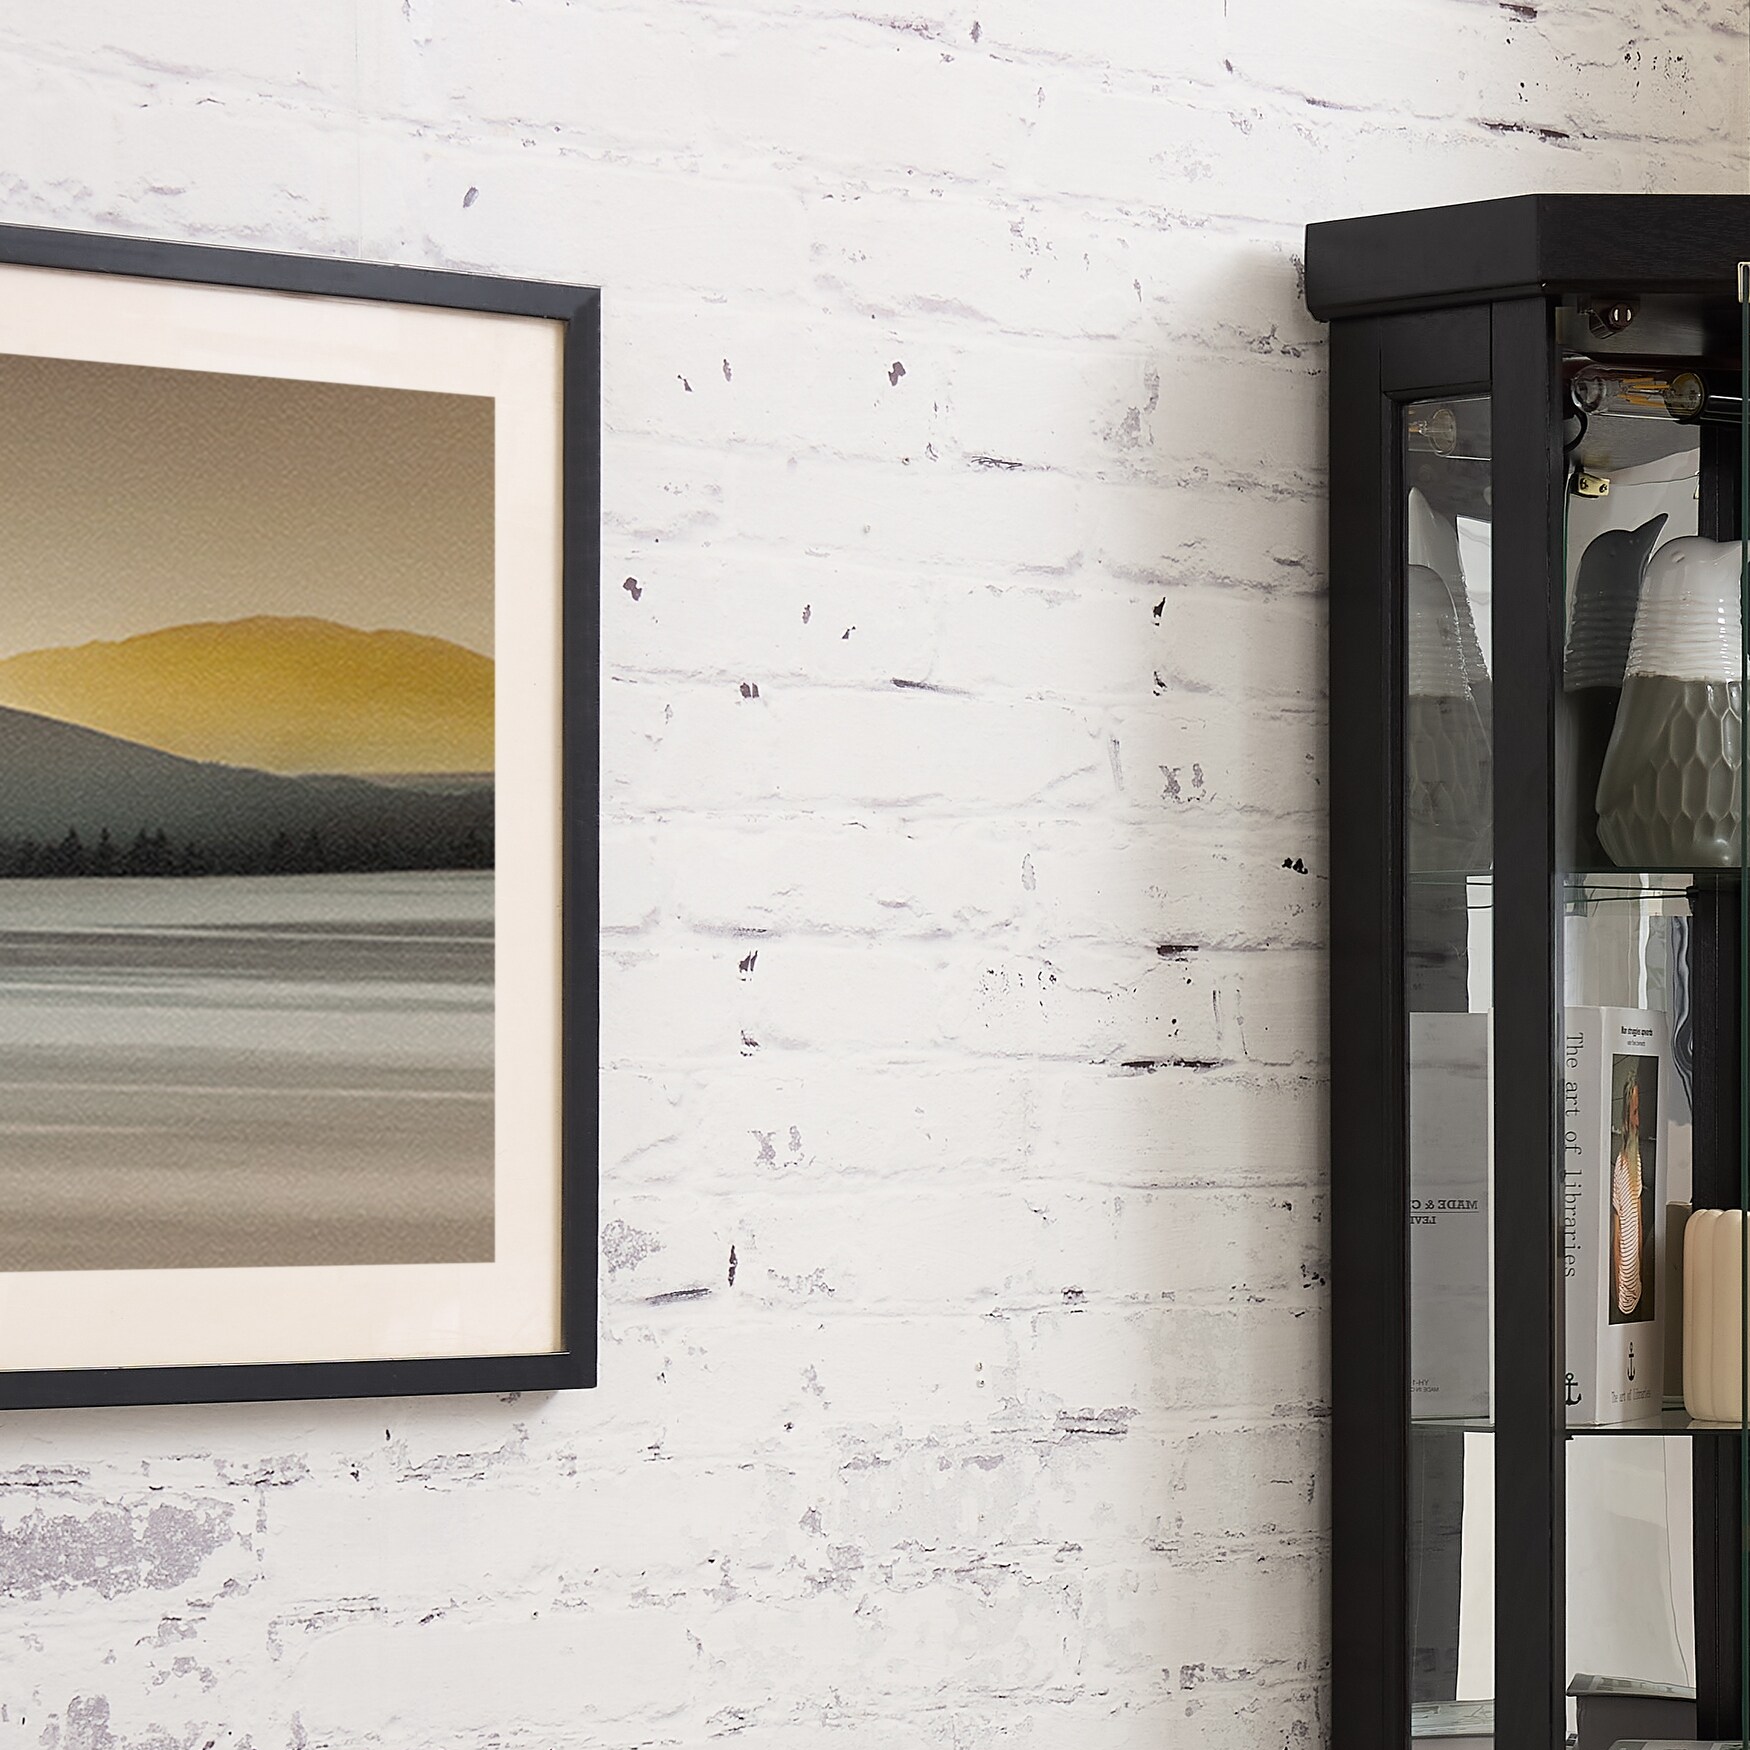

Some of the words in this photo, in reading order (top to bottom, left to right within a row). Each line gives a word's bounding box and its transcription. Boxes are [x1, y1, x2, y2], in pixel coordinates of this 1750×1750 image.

[1566, 1032, 1584, 1069] The
[1565, 1081, 1581, 1117] art
[1565, 1130, 1582, 1155] of
[1564, 1169, 1583, 1277] libraries
